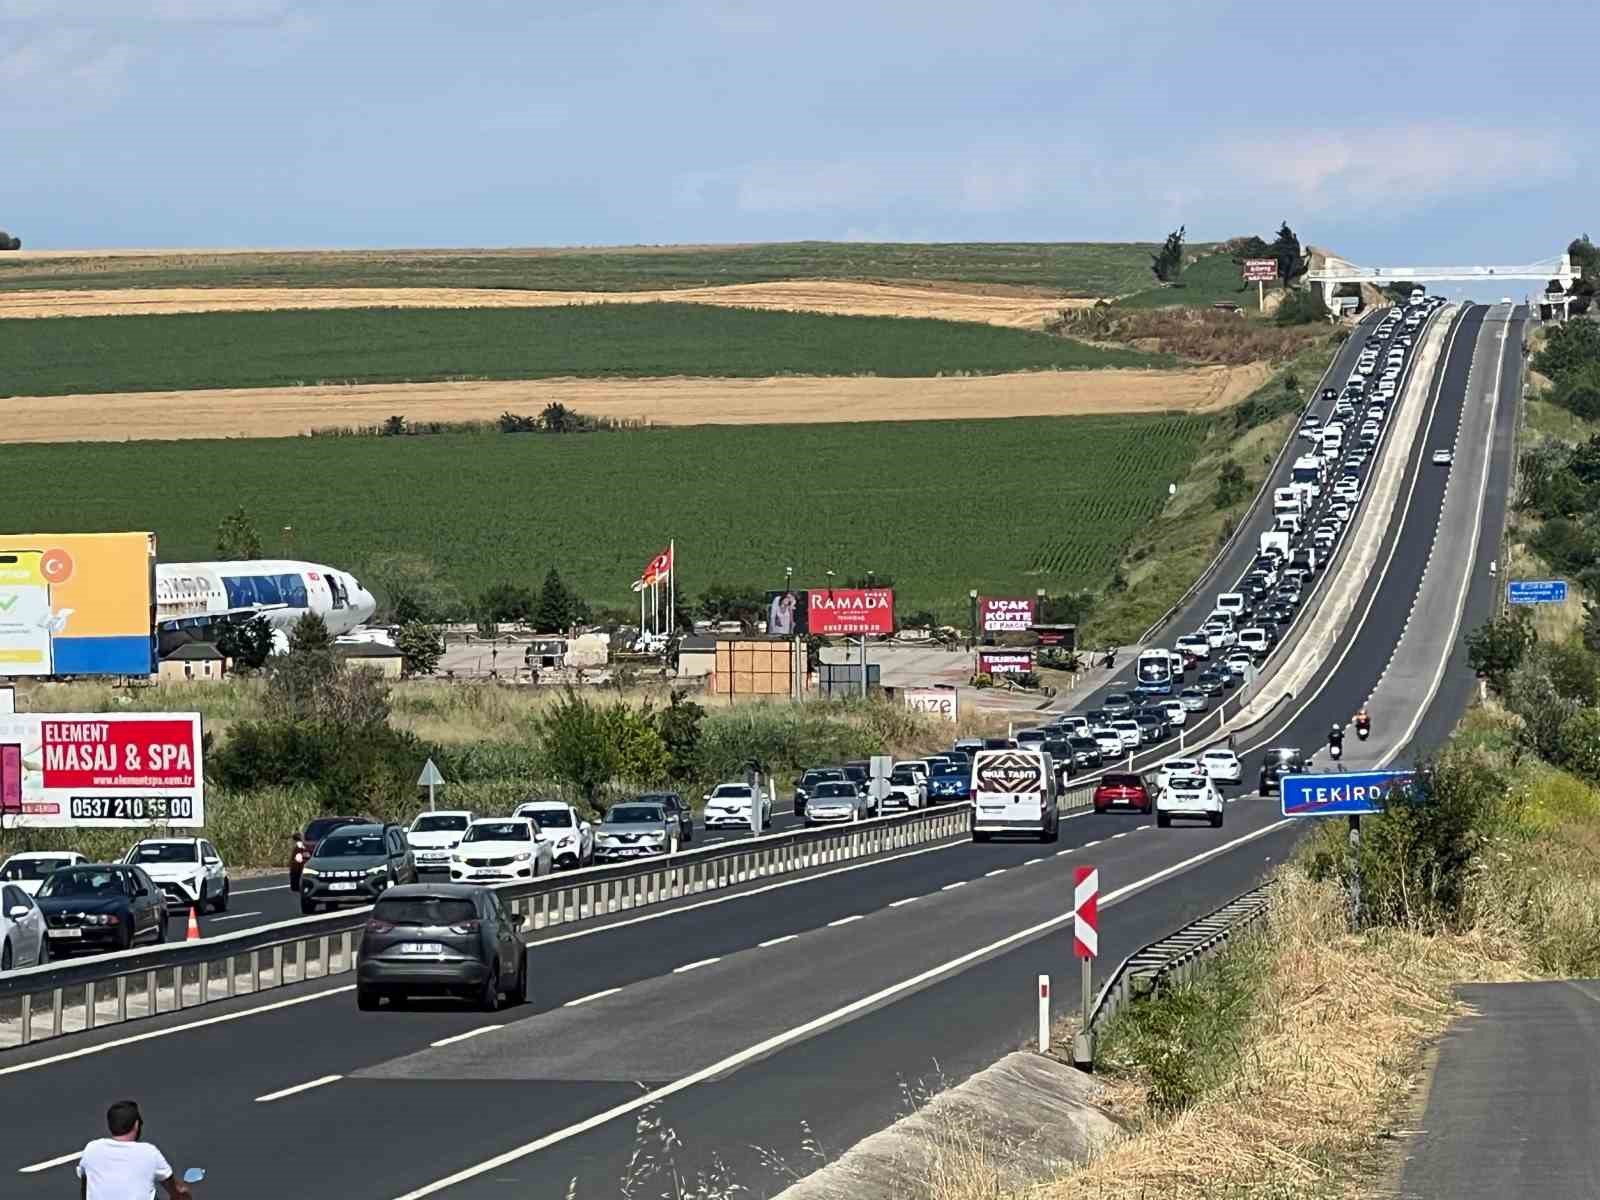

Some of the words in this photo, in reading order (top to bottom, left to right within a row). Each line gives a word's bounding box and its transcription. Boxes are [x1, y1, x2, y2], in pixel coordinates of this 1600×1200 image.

[989, 600, 1028, 611] UÇAK
[985, 611, 1032, 621] KÖFTE
[45, 724, 109, 742] ELEMENT
[46, 743, 117, 771] MASAJ
[126, 743, 141, 771] &
[149, 743, 192, 771] SPA
[72, 798, 109, 816] 0537
[114, 798, 142, 816] 210
[171, 798, 190, 816] 00
